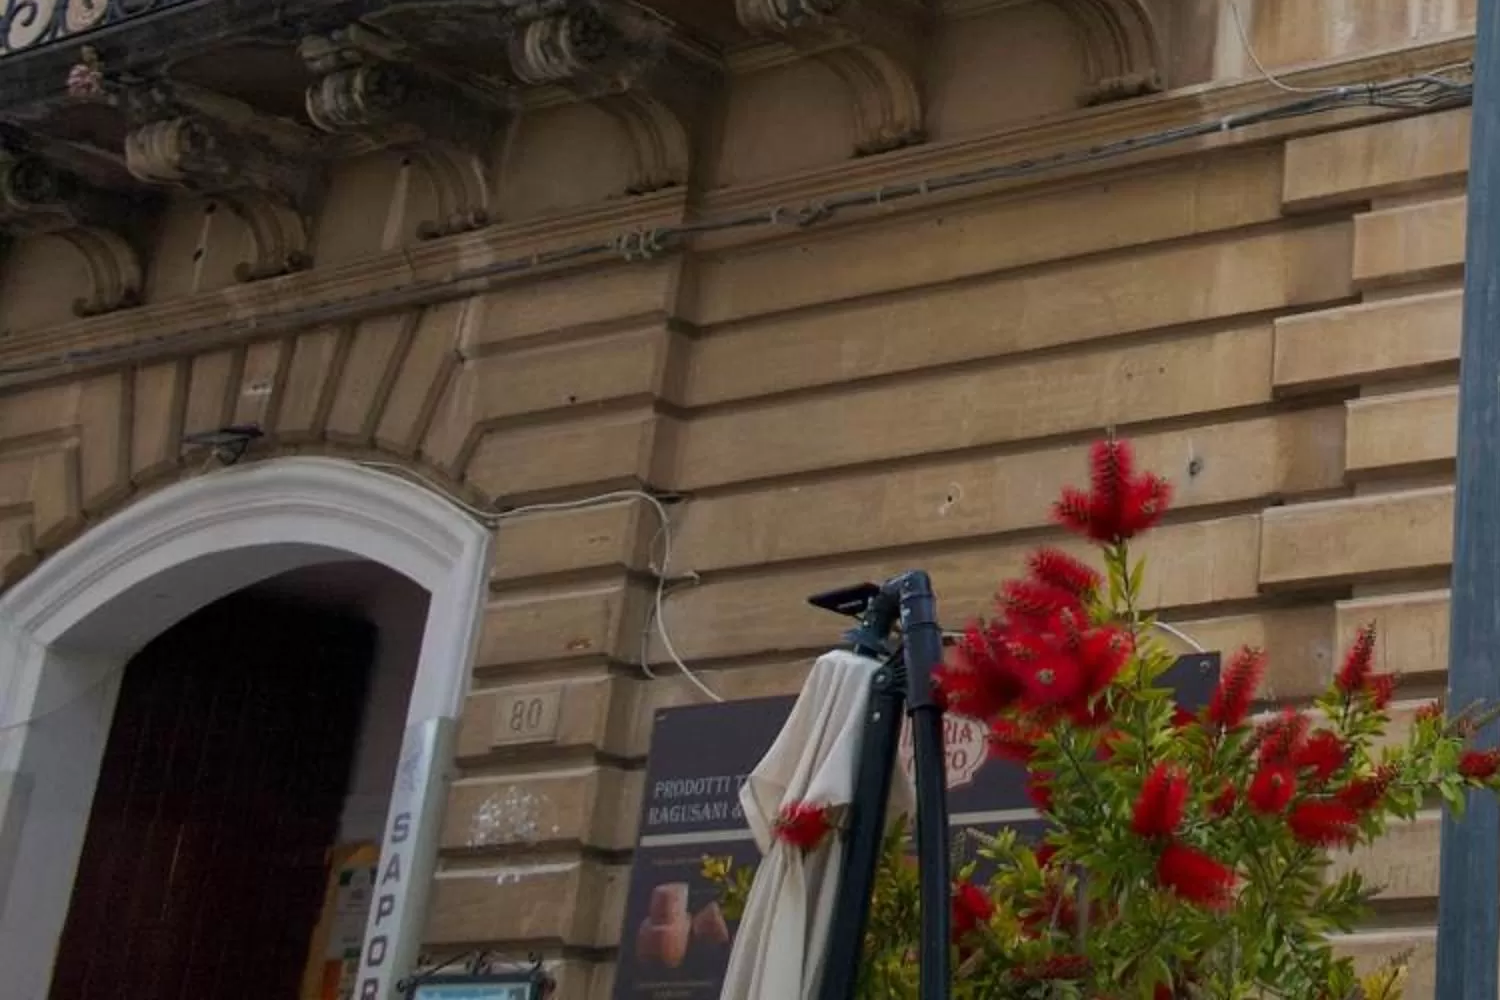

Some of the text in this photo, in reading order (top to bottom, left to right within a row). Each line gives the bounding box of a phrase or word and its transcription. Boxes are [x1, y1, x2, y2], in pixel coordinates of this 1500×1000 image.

[509, 698, 544, 731] 80
[654, 775, 731, 800] PRODOTTI
[647, 800, 729, 825] RAGUSANI
